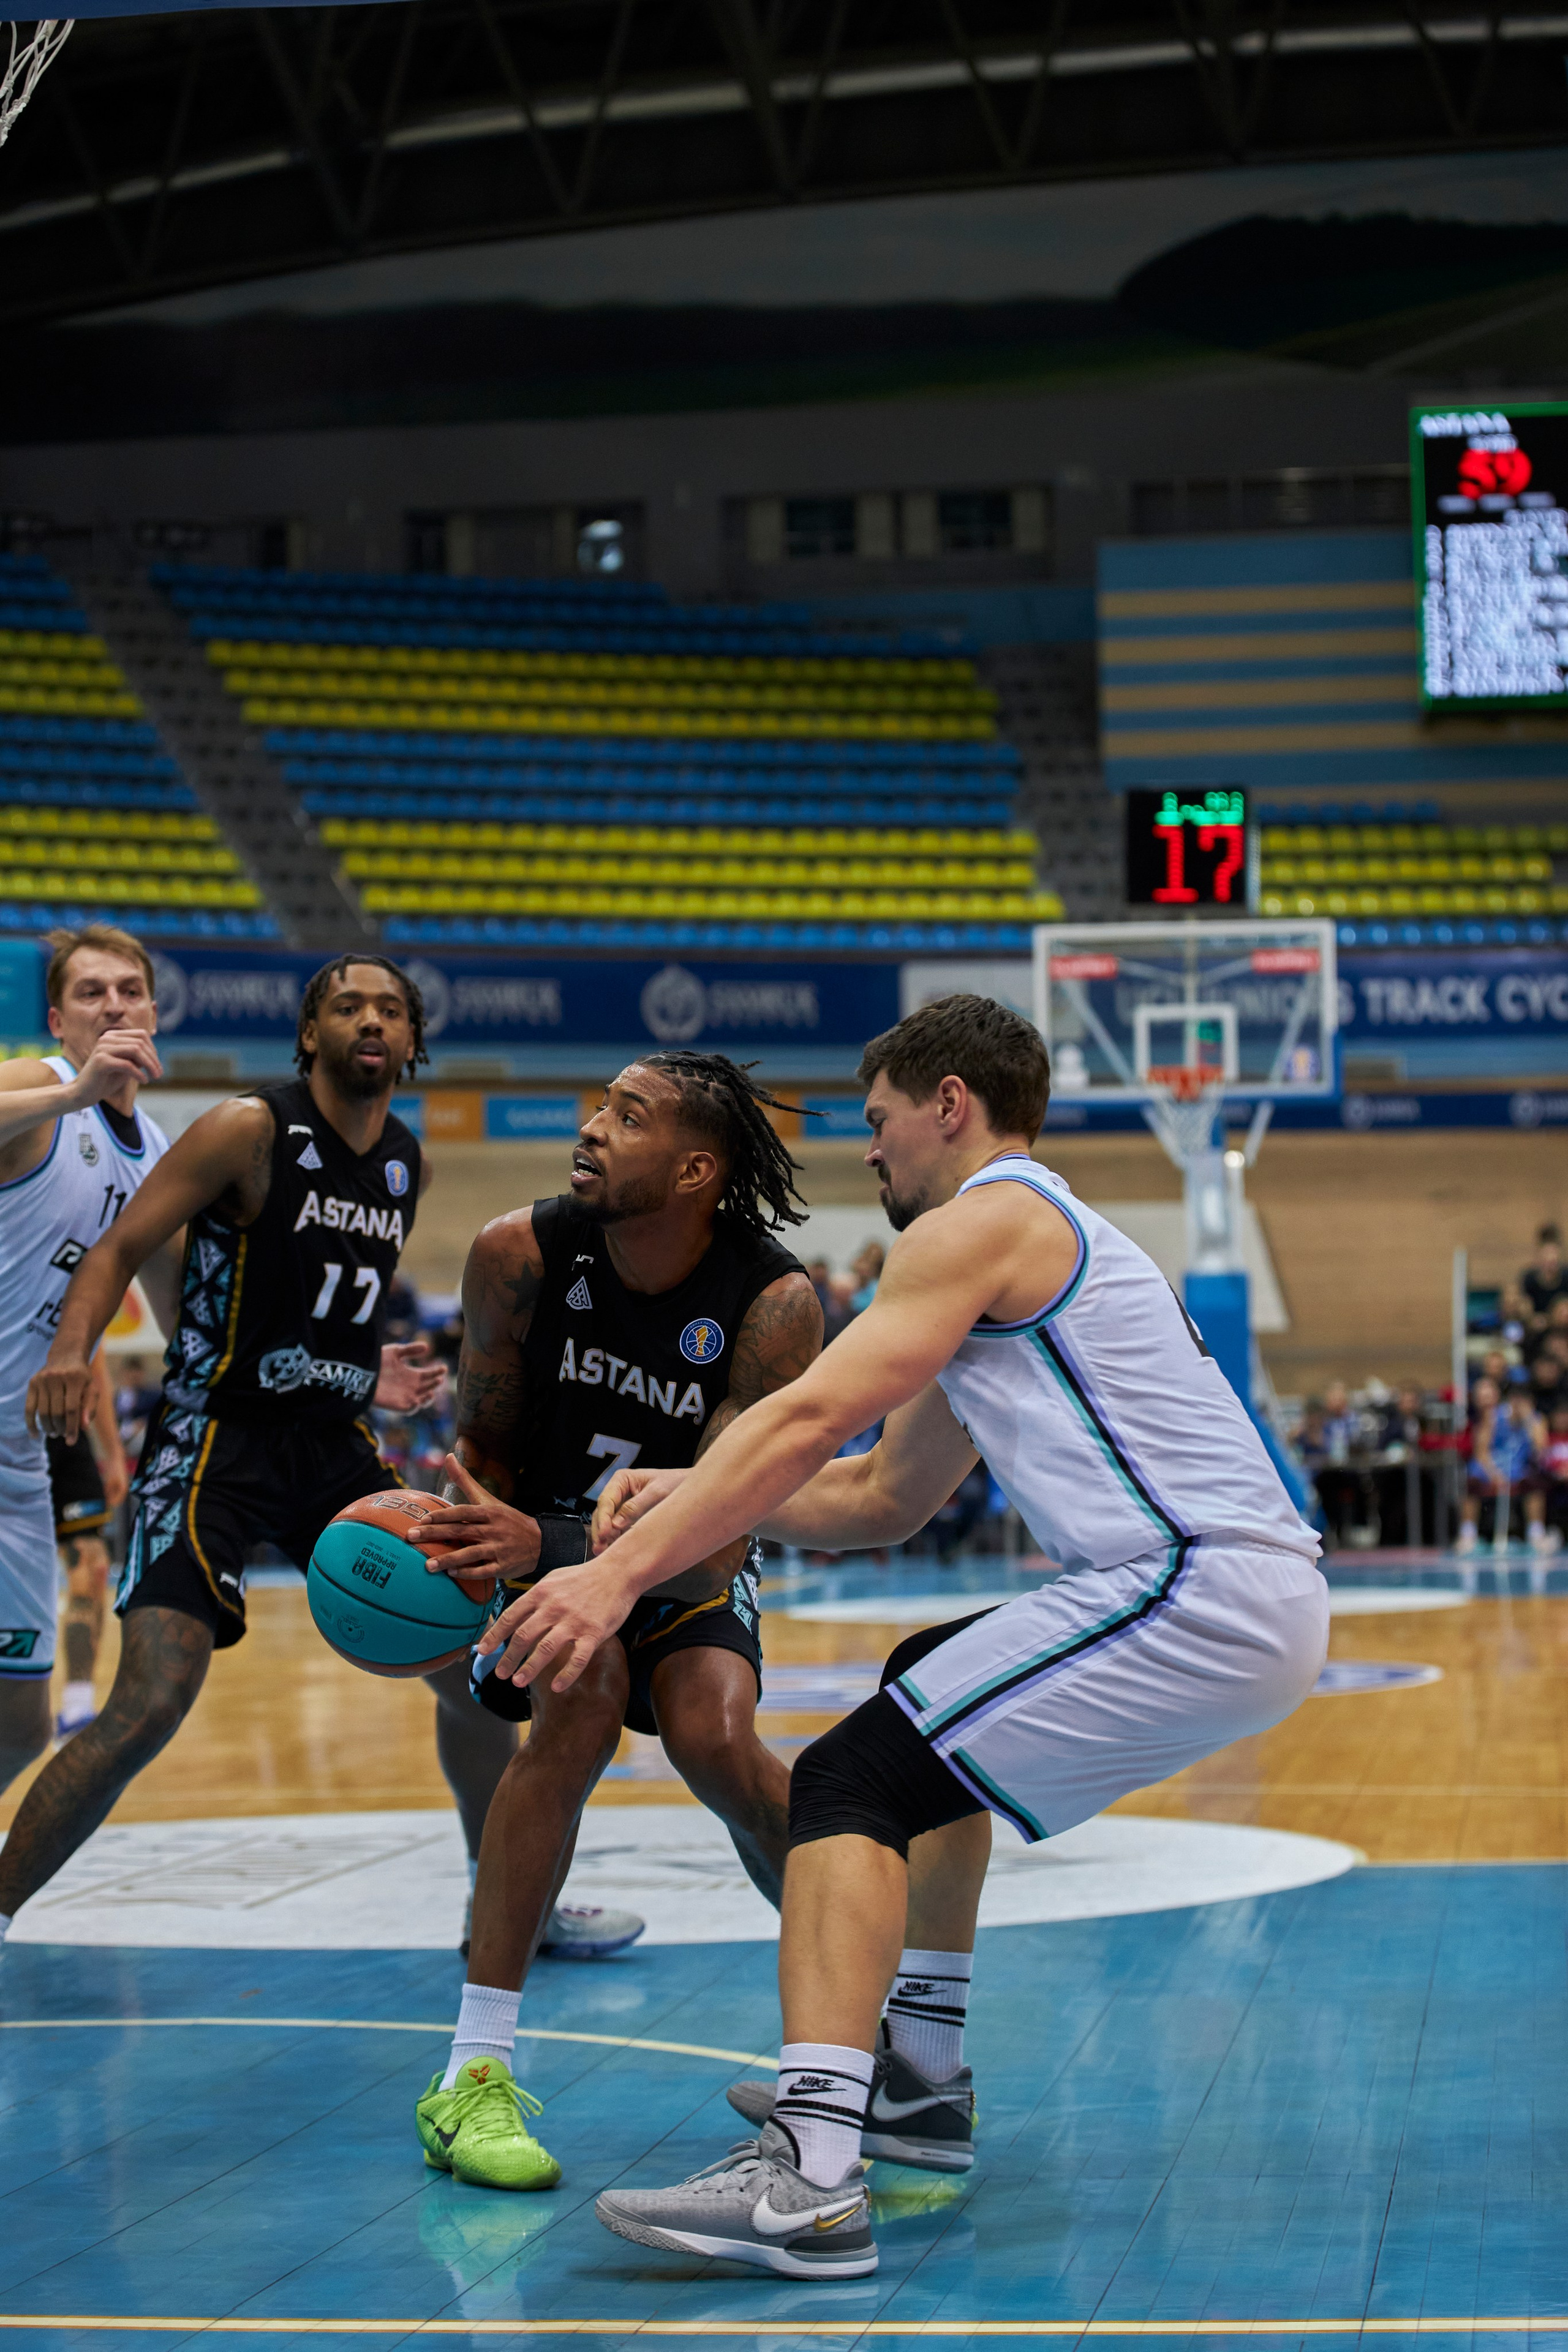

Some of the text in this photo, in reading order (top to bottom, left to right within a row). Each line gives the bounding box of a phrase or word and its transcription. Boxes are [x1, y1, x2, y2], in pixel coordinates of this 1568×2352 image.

[1152, 824, 1245, 903] 17
[1360, 978, 1491, 1023] TRACK
[293, 1189, 404, 1253] ASTANA
[311, 1262, 381, 1325] 17
[559, 1336, 706, 1426] ASTANA
[582, 1433, 643, 1501] 7
[352, 1555, 391, 1589] FIBA
[361, 1547, 397, 1570] APPROVED
[903, 1981, 935, 1992] NIKE
[797, 2075, 834, 2089] NIKE
